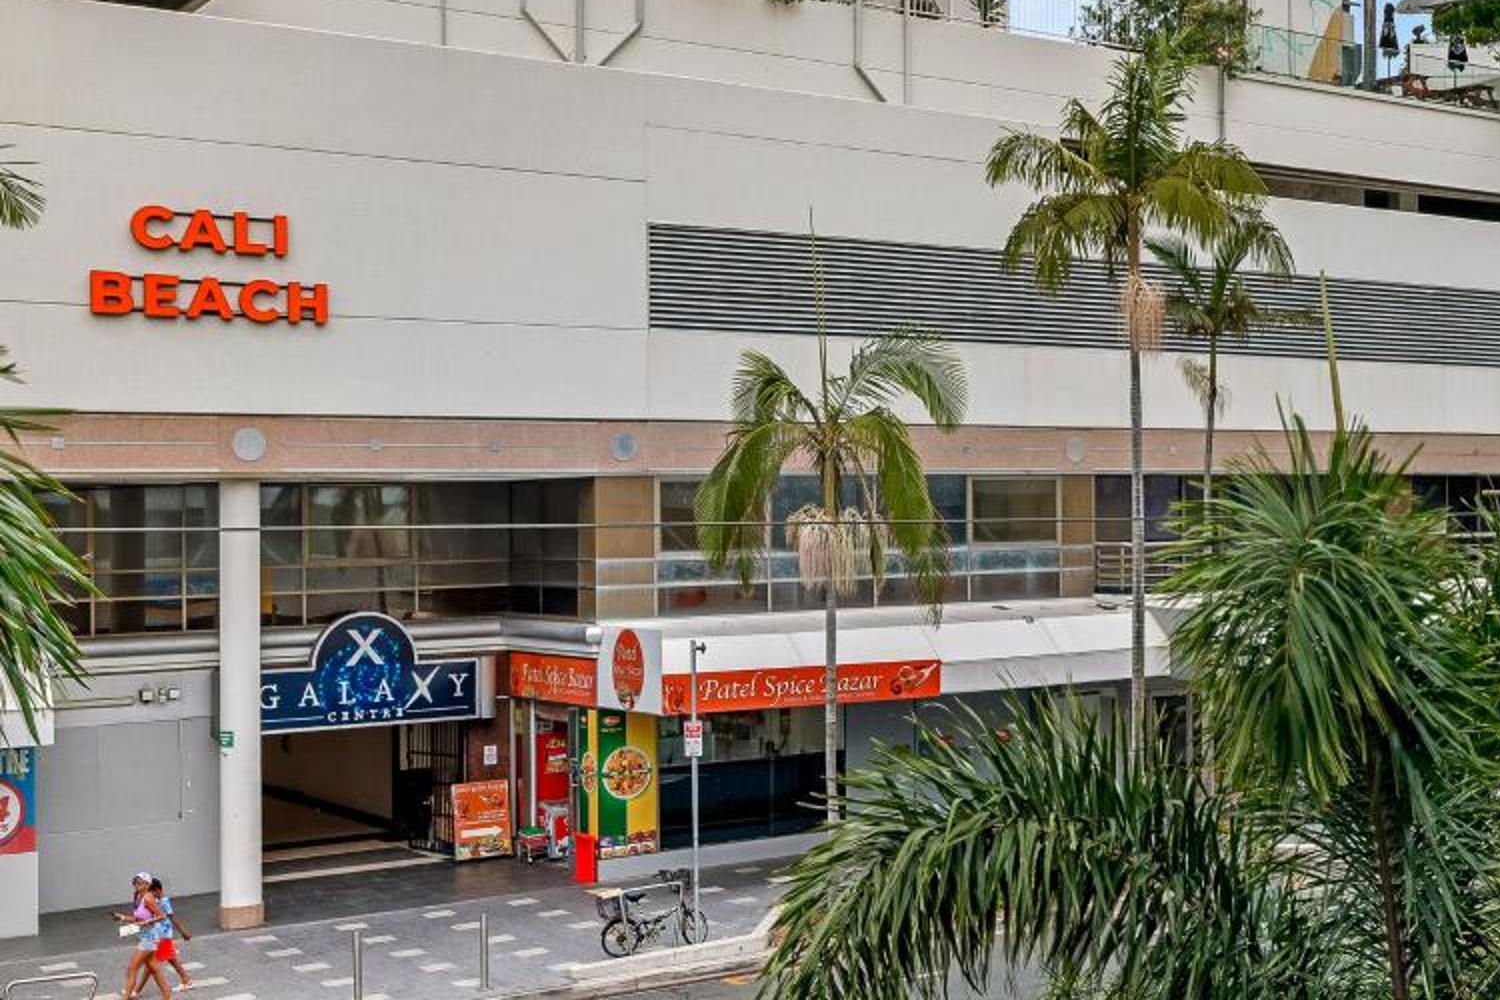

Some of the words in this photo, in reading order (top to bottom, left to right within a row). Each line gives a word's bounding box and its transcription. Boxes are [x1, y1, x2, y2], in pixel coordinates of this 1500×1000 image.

[130, 204, 289, 257] CALI
[89, 269, 330, 327] BEACH
[260, 665, 469, 710] GALAXY
[699, 671, 763, 701] Patel
[763, 673, 816, 708] Spice
[327, 706, 406, 722] CENTRE
